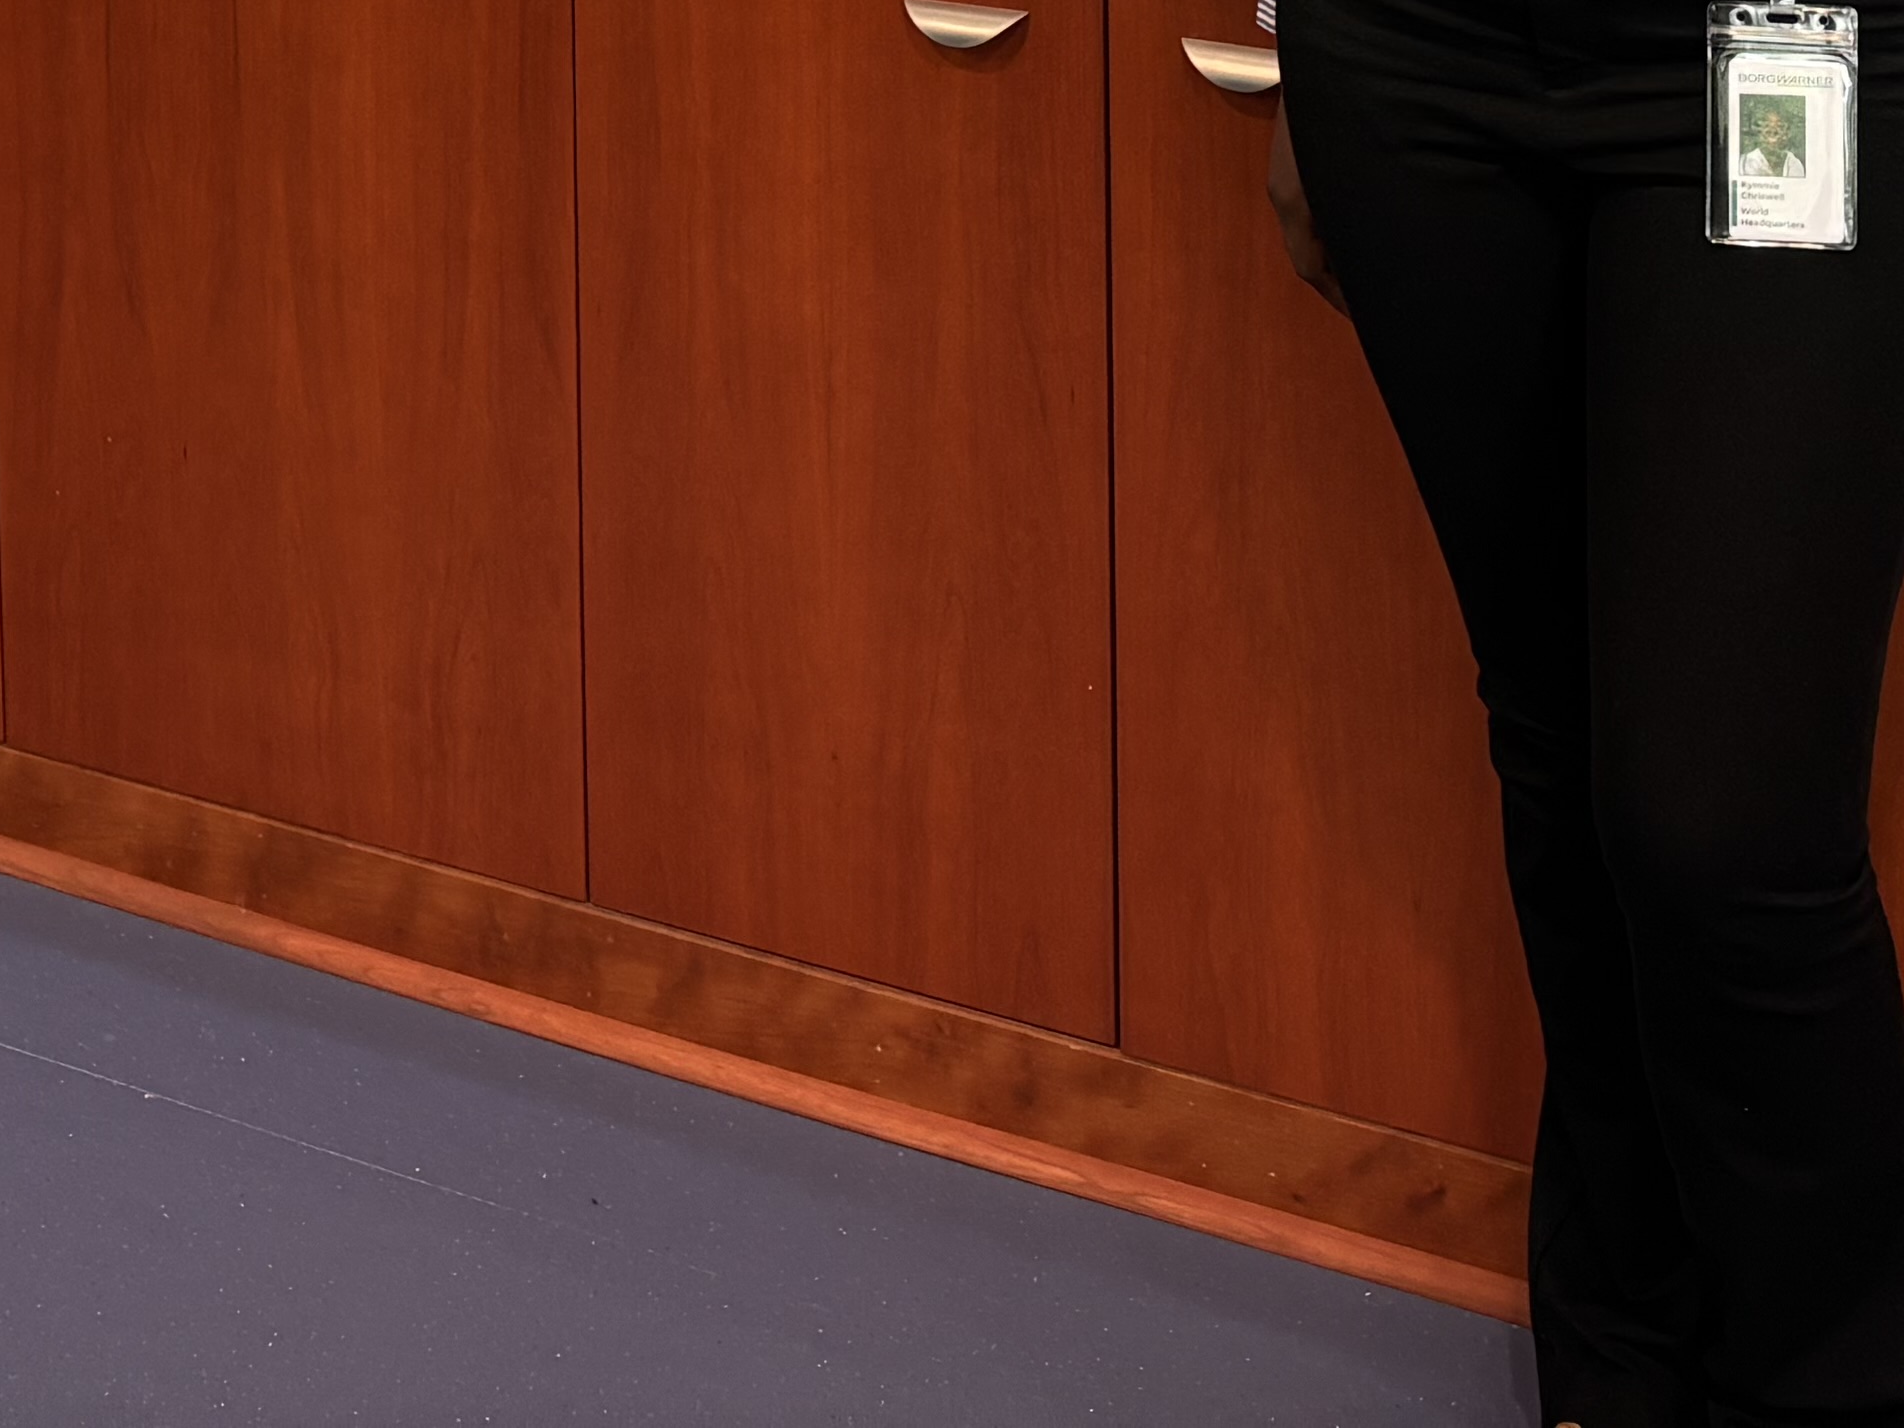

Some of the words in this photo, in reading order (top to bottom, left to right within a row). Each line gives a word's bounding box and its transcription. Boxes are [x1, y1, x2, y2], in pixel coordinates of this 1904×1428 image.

[1738, 73, 1833, 88] BORGWARNER
[1741, 207, 1769, 215] World
[1741, 219, 1804, 228] Headquarters
